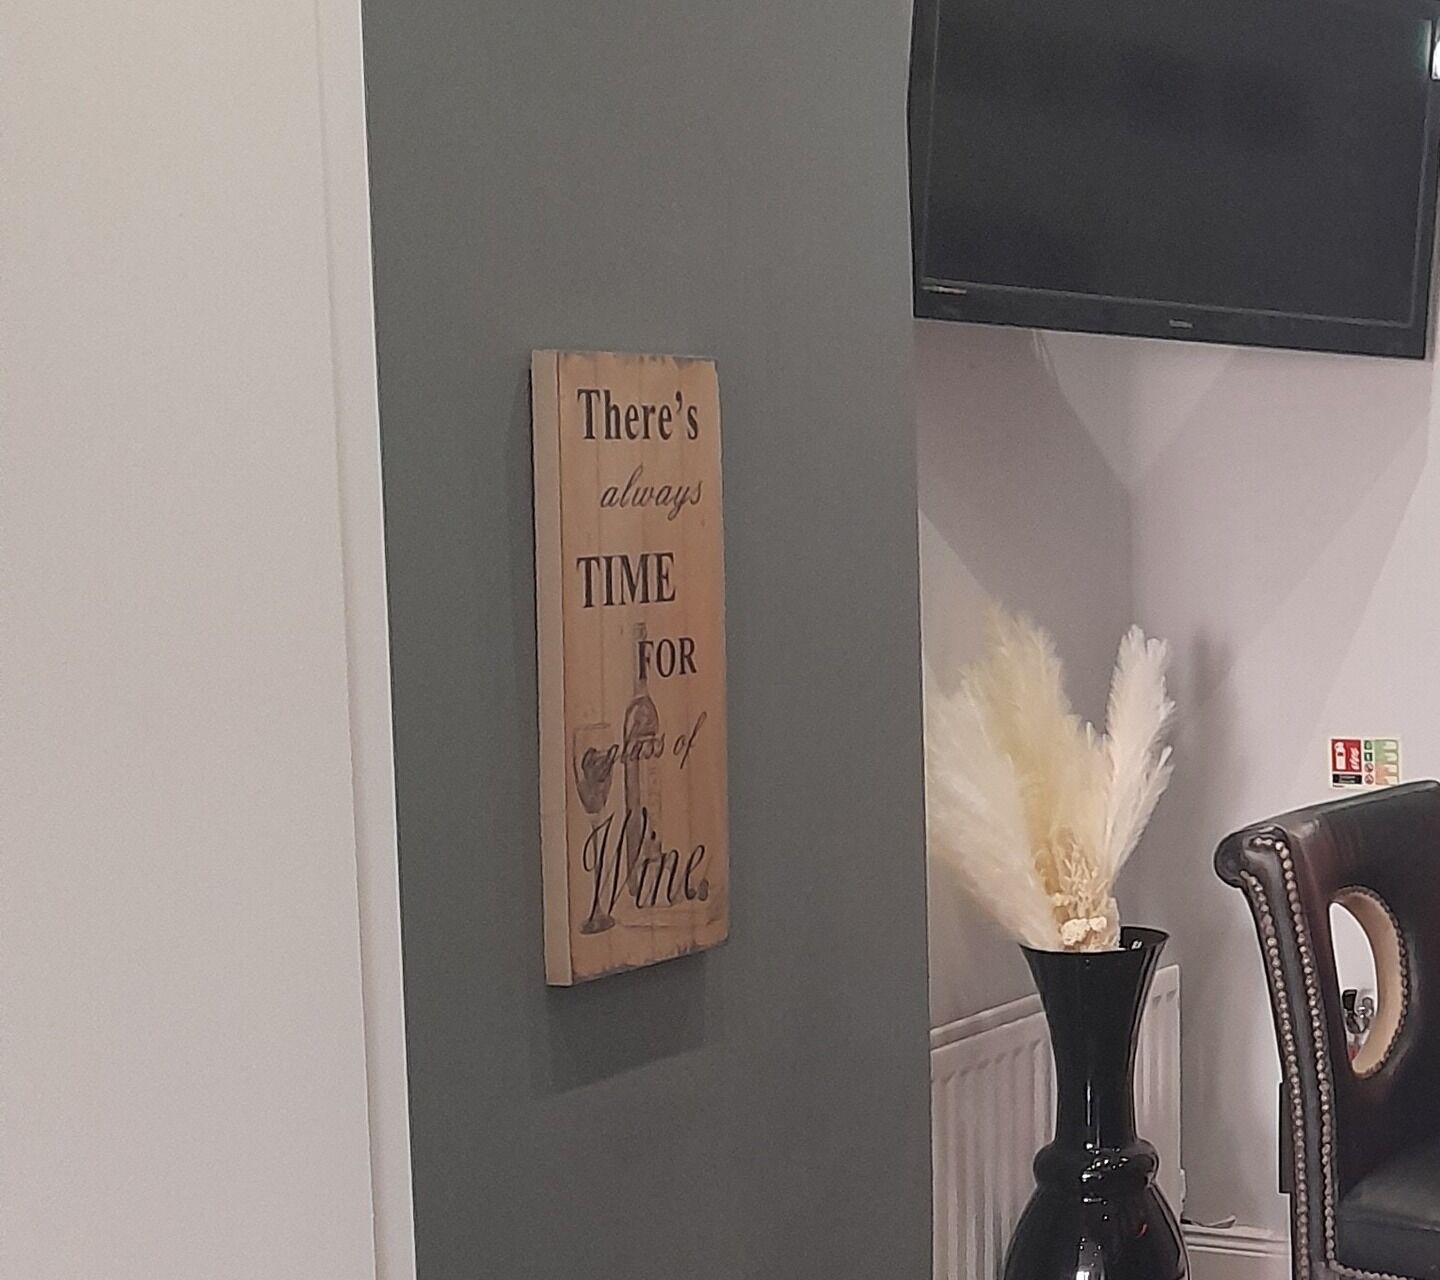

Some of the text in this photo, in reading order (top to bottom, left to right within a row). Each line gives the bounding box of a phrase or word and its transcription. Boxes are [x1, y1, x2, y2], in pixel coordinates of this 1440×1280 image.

[577, 390, 698, 440] There's
[601, 464, 702, 520] always
[577, 552, 676, 608] TIME
[638, 637, 697, 680] FOR
[673, 712, 707, 769] of
[583, 807, 705, 921] Wine
